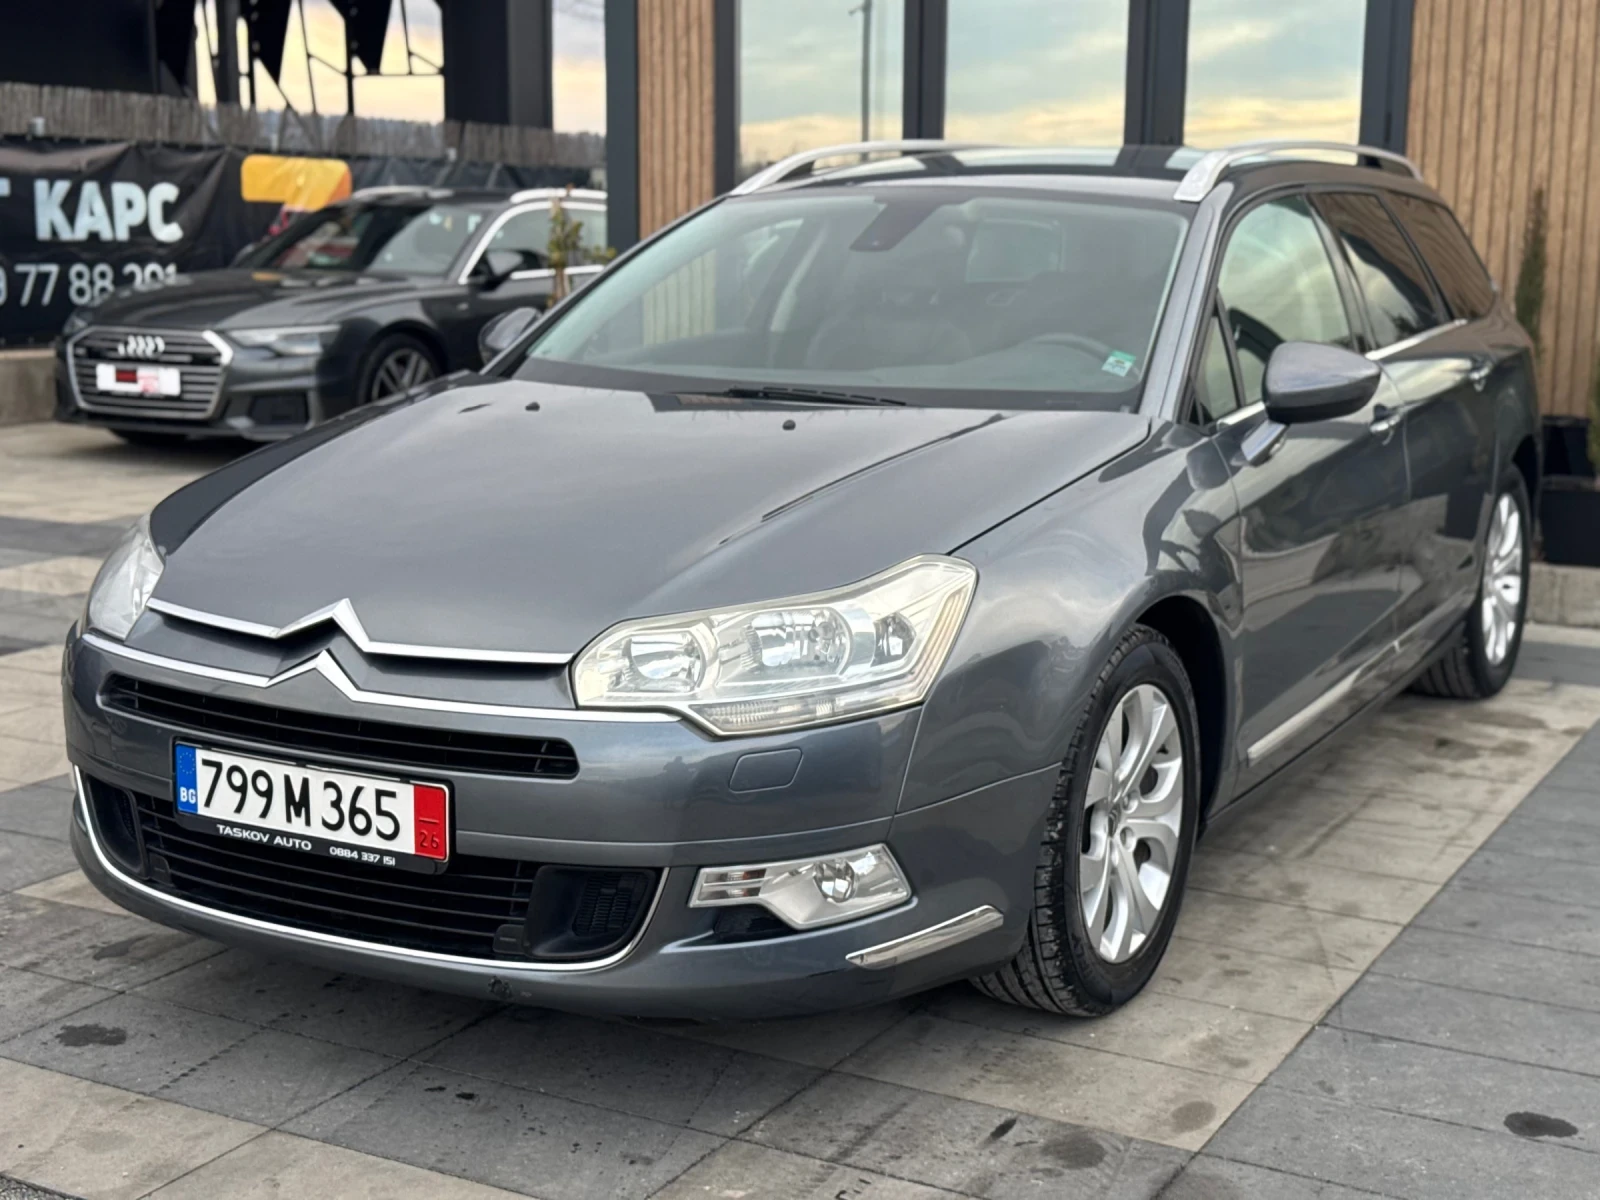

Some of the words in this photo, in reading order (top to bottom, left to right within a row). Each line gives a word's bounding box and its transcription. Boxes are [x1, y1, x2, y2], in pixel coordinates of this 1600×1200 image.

[34, 179, 184, 243] КАРС
[14, 263, 60, 307] 77
[68, 262, 115, 307] 88
[180, 786, 197, 804] BG
[201, 758, 273, 819] 799
[283, 773, 311, 828] M
[321, 780, 401, 841] 365
[216, 824, 270, 843] TASKOV
[273, 836, 312, 851] AUTO
[329, 846, 359, 860] 0884
[361, 851, 381, 864] 337
[419, 829, 440, 850] 26
